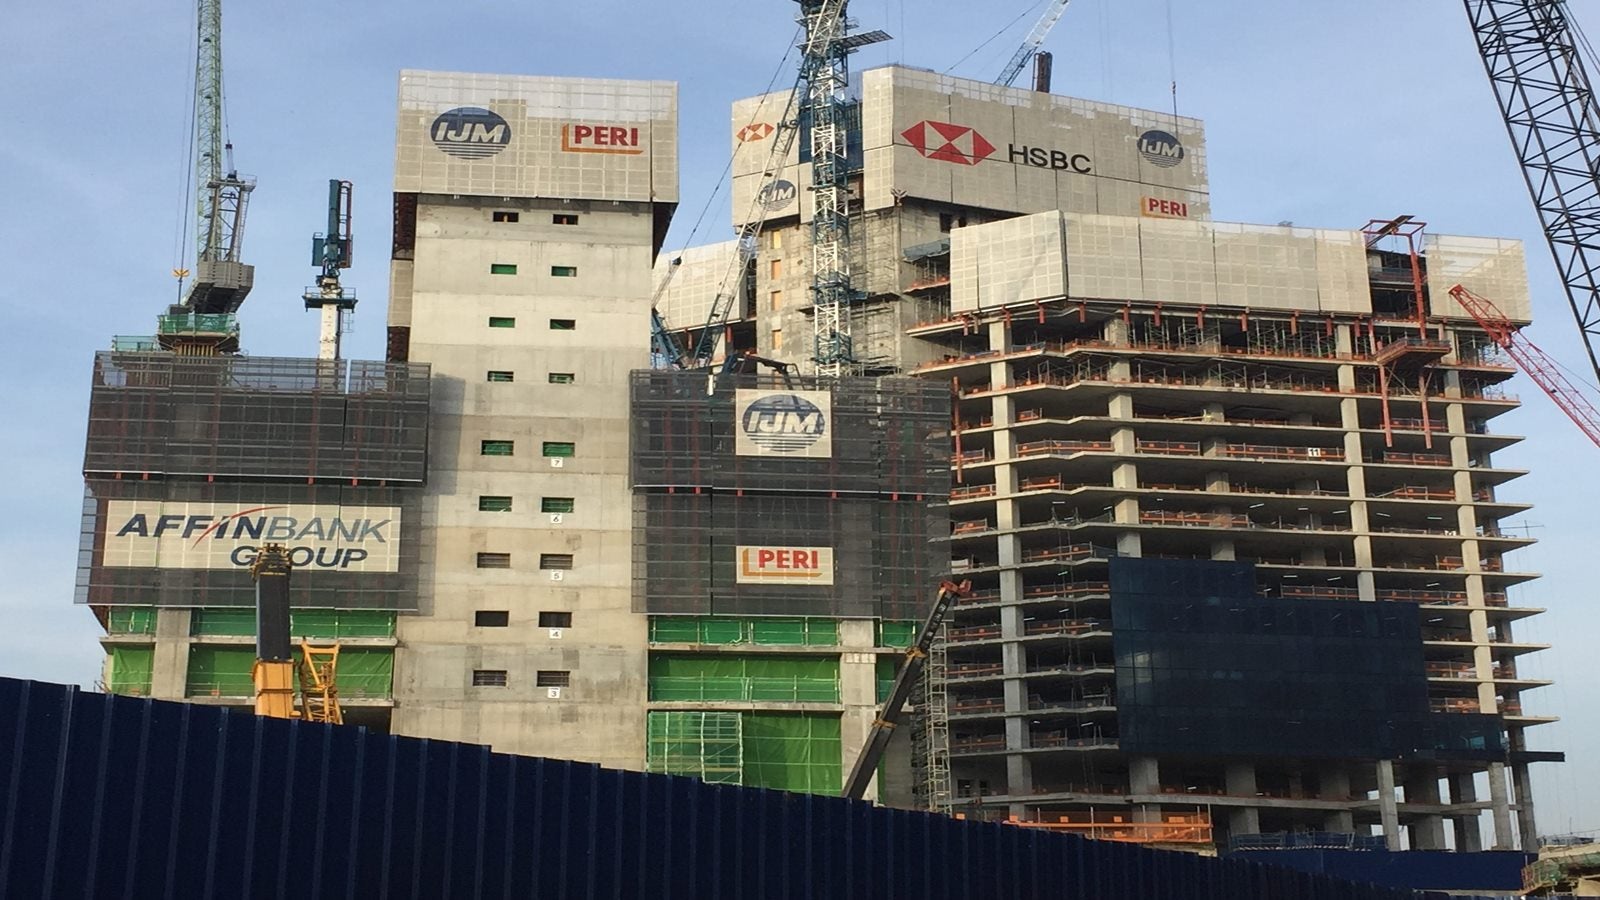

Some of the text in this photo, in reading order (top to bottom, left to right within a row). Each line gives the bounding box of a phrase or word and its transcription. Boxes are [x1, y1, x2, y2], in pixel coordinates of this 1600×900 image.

[434, 121, 504, 143] IJM
[574, 125, 639, 146] PERI
[1008, 143, 1092, 174] HSBC
[1141, 138, 1182, 158] IJM
[1149, 198, 1187, 217] PERI
[746, 410, 819, 433] IJM
[230, 545, 368, 568] GOUP
[758, 550, 818, 569] PERI
